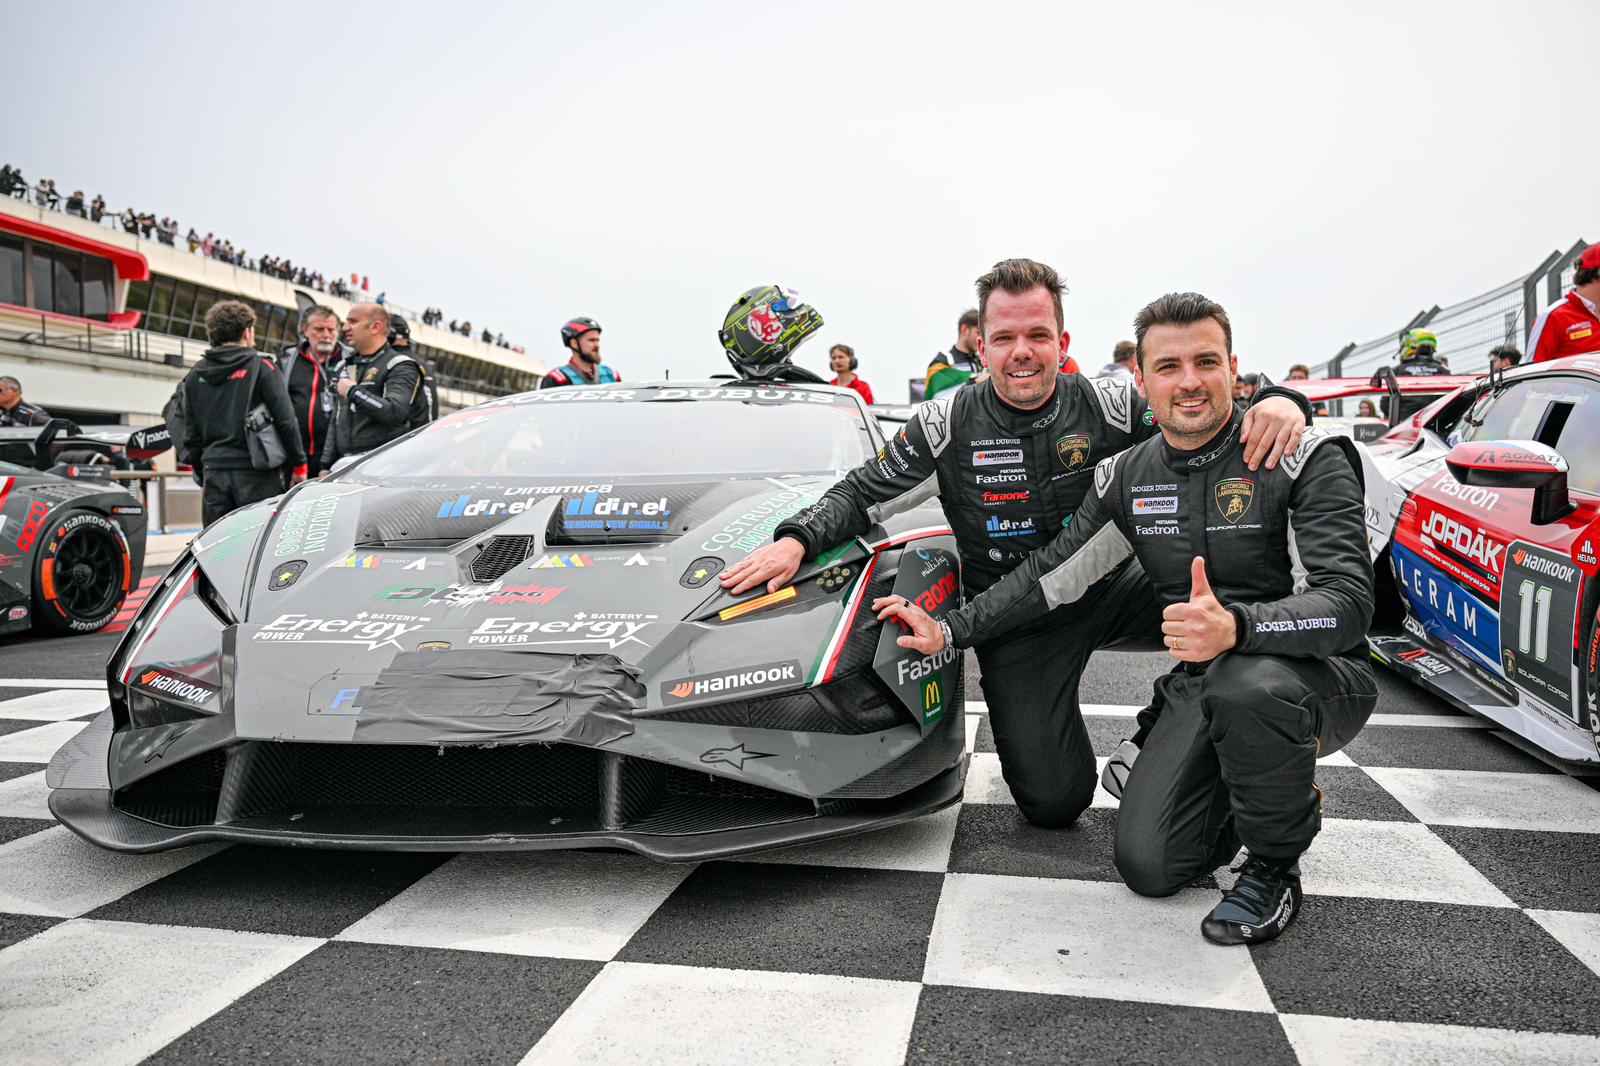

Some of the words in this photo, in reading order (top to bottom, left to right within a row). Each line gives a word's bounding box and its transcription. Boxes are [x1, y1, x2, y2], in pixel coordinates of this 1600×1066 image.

[655, 387, 836, 403] DUBUIS
[976, 474, 1027, 484] Fastron
[1432, 474, 1500, 511] Fastron
[563, 520, 602, 530] SENDING
[629, 520, 669, 530] SIGNALS
[1135, 525, 1180, 535] Fastron
[1421, 510, 1504, 573] JORDÁK
[1523, 554, 1576, 583] HANKOOK
[370, 613, 419, 621] BATTERY
[1255, 621, 1296, 633] ROGER
[1296, 617, 1337, 630] DUBUIS
[1519, 579, 1553, 663] 11
[252, 631, 306, 641] POWER
[261, 614, 425, 641] Energy
[471, 617, 655, 639] Energy
[467, 634, 529, 644] POWER
[149, 671, 213, 703] HANKOOK
[694, 665, 796, 695] HANKOOK
